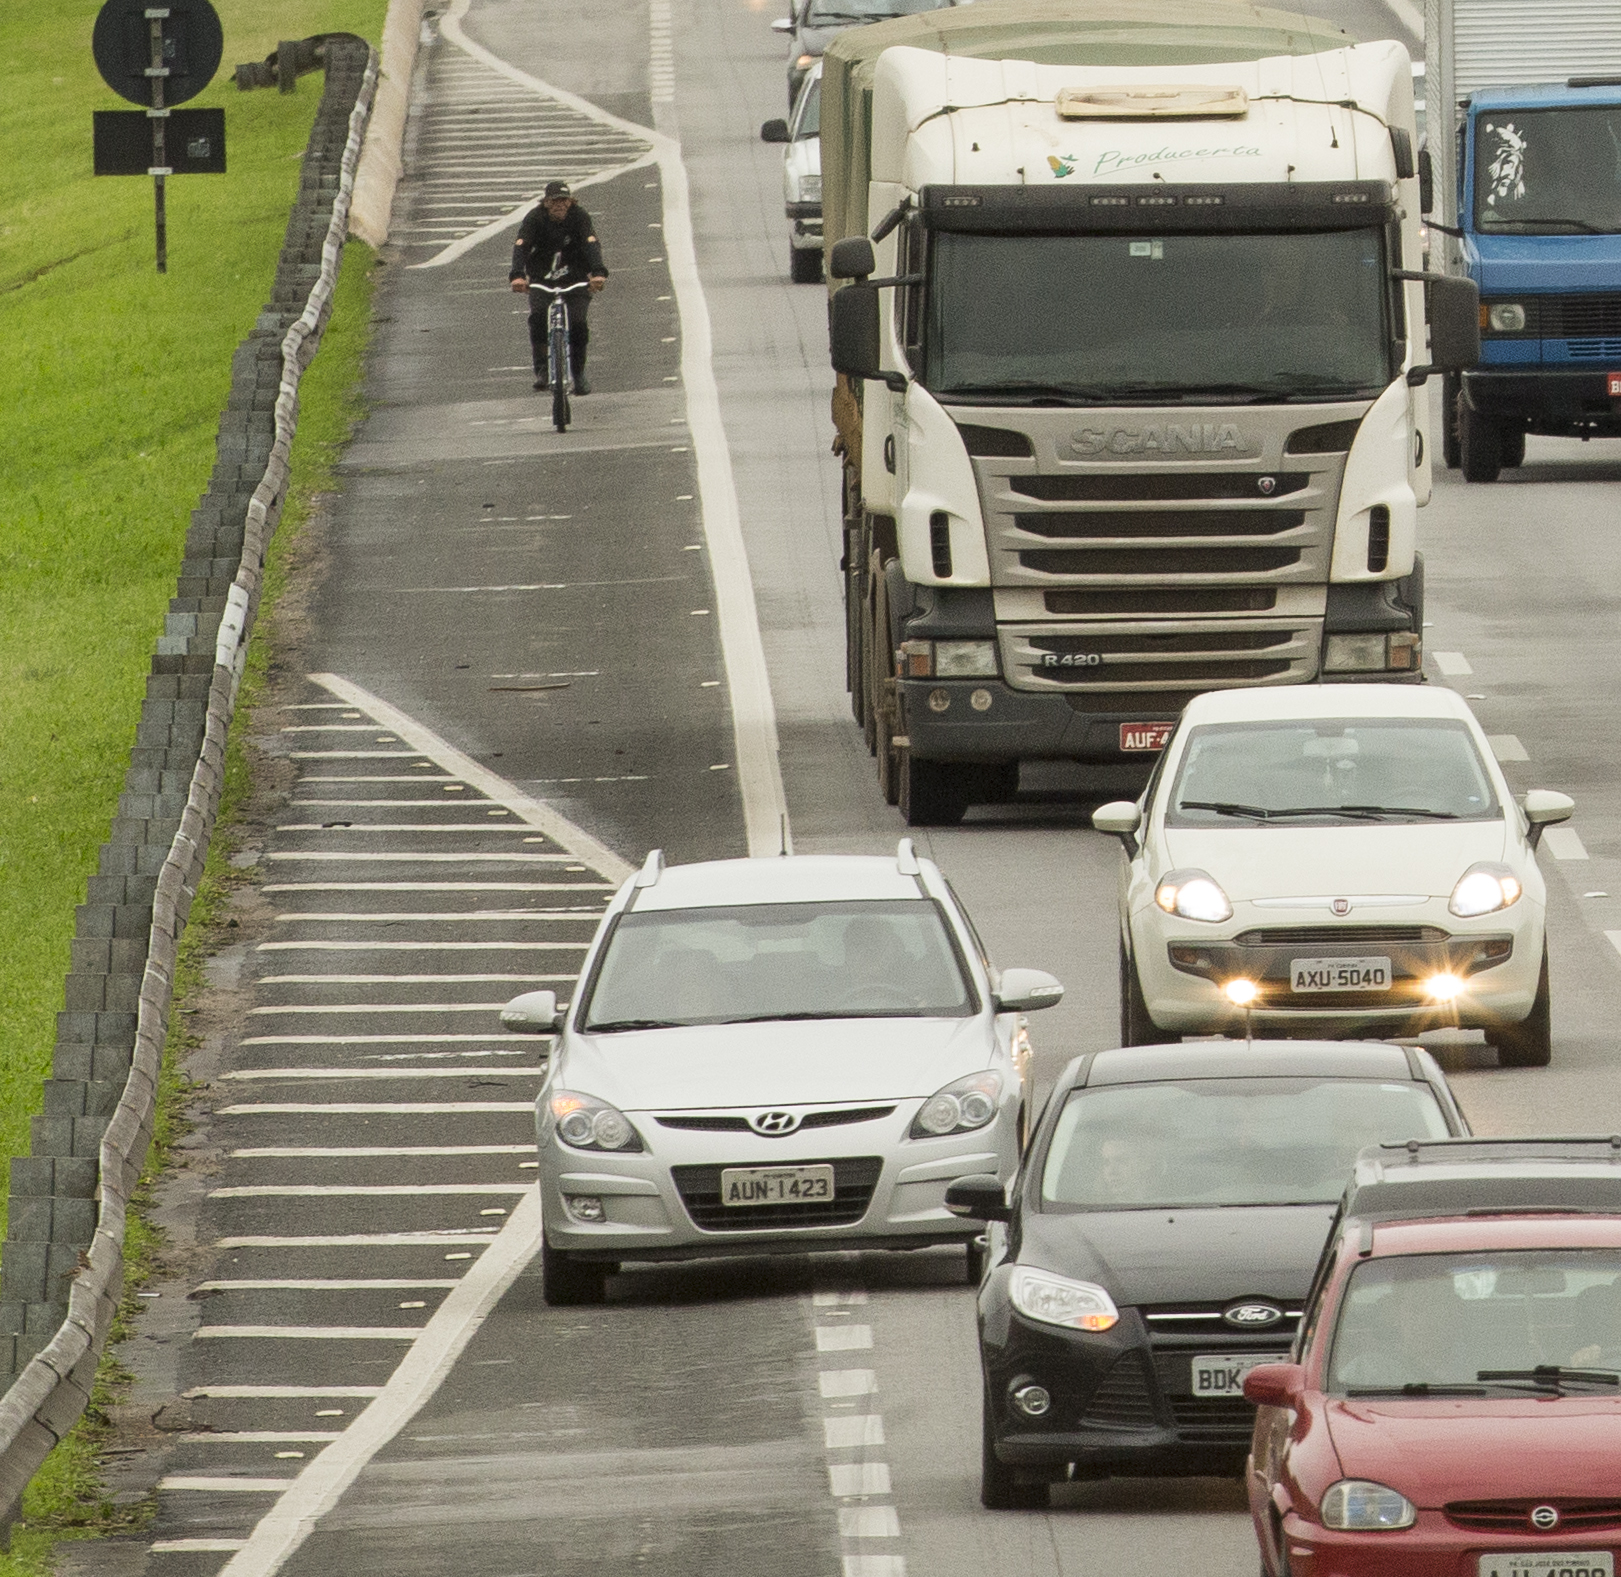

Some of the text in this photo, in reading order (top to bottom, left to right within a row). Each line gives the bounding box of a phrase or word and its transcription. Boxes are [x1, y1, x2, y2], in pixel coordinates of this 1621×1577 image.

[1093, 147, 1262, 174] Producerta
[1071, 423, 1250, 456] SCANIA
[1295, 968, 1385, 988] AXU-5040
[727, 1179, 826, 1202] AUN-1423
[1237, 1306, 1269, 1321] Ford
[1198, 1369, 1241, 1390] BDK
